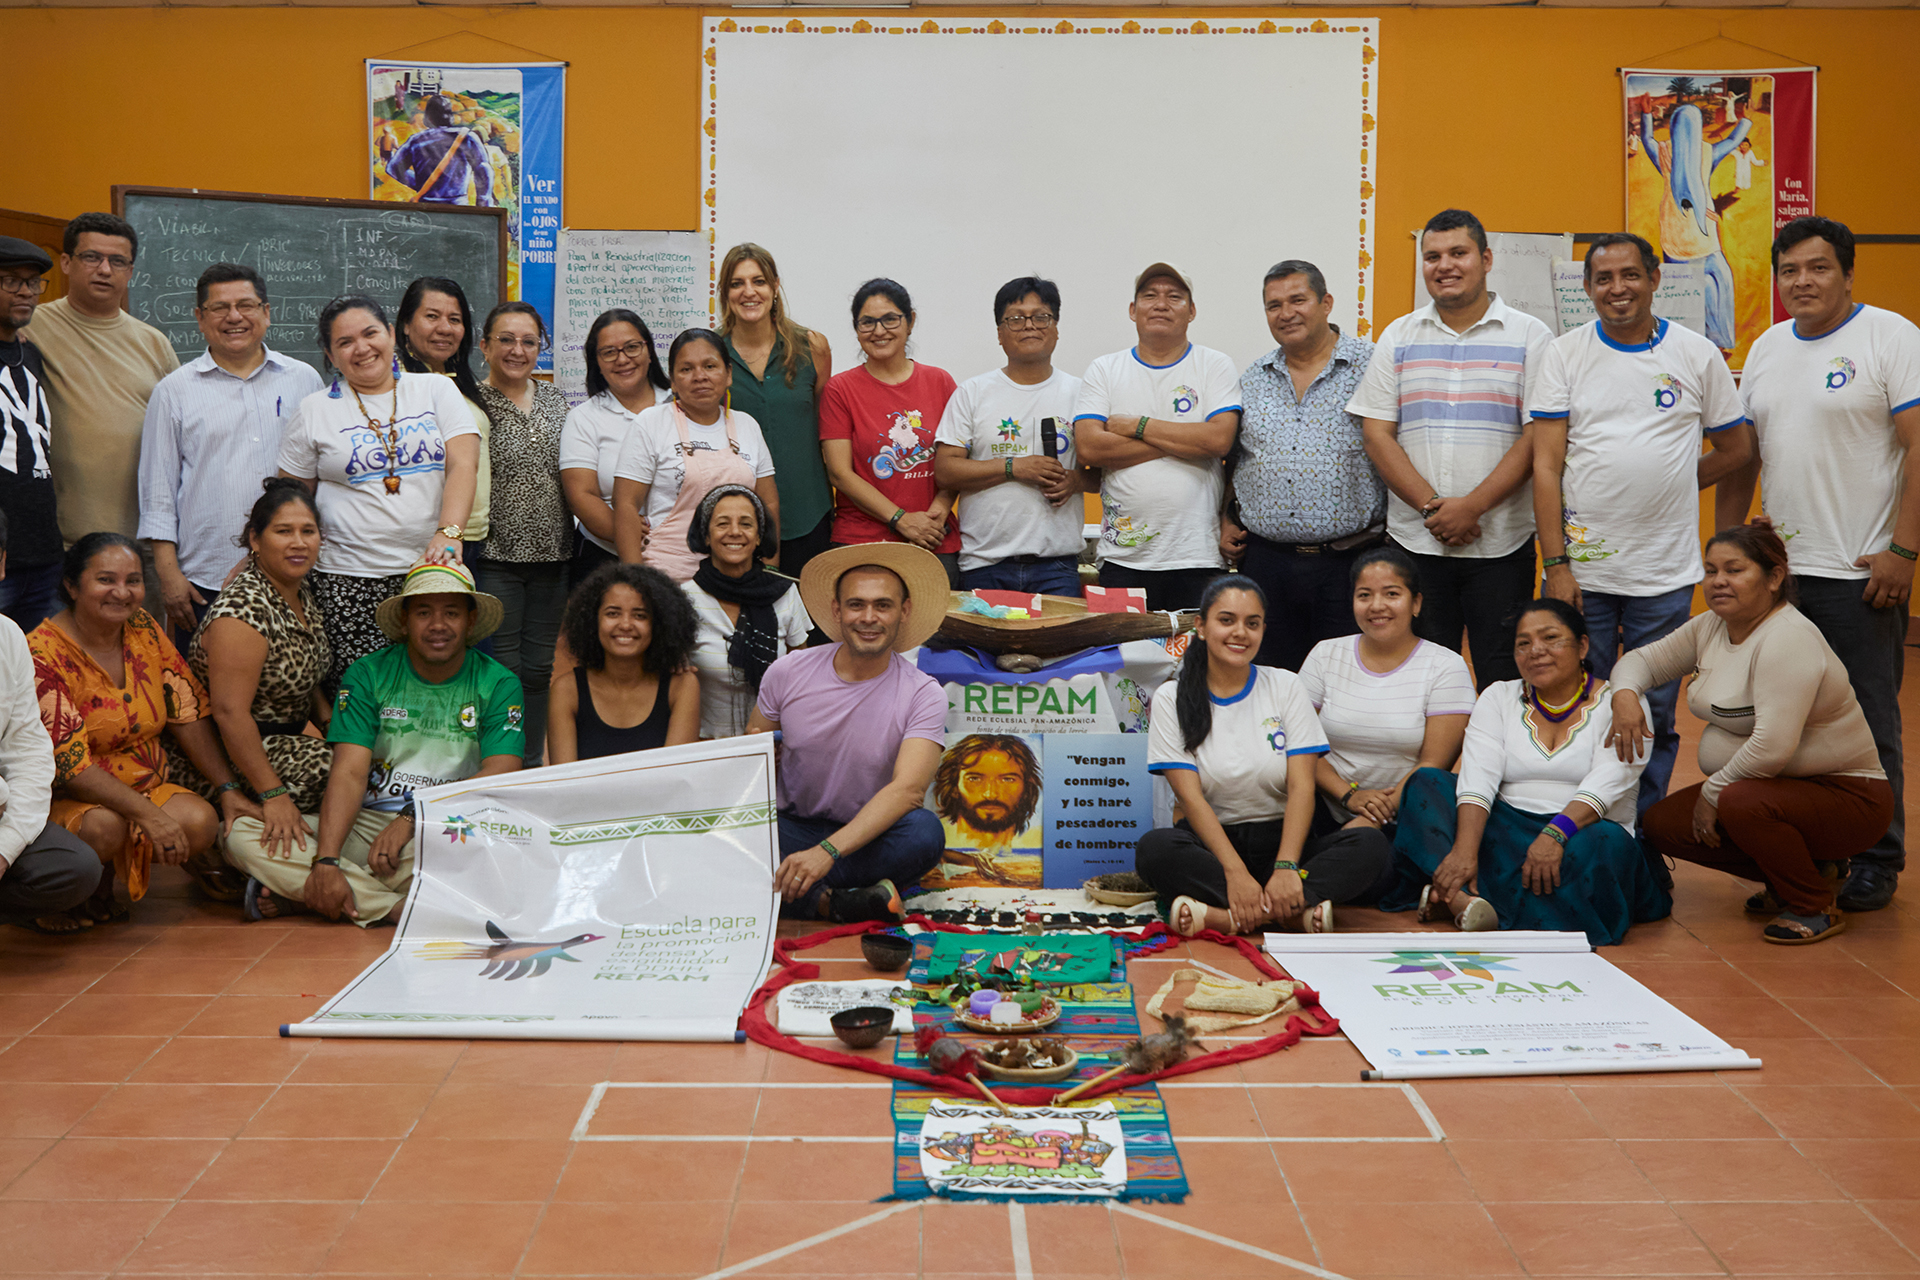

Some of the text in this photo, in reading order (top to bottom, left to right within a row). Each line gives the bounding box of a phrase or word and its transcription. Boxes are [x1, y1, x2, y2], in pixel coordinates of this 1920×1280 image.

[527, 174, 556, 193] Ver
[1785, 177, 1802, 188] Con
[523, 196, 558, 204] EL MUNDO
[1777, 204, 1809, 218] salgan
[531, 215, 558, 228] OJOS
[1775, 217, 1791, 229] de
[529, 237, 553, 248] niño
[567, 250, 587, 261] Para
[592, 251, 600, 260] la
[602, 263, 616, 273] del
[166, 275, 199, 288] ECON
[566, 274, 579, 285] del
[583, 275, 606, 284] cobre
[611, 277, 618, 287] y
[652, 275, 695, 285] minerales
[569, 298, 601, 308] mineral
[164, 303, 196, 317] SOCI
[569, 308, 588, 318] Para
[645, 320, 688, 329] ostenible
[351, 422, 430, 447] FÓUM
[991, 443, 1028, 454] REPAM
[964, 685, 1096, 715] REPAM
[393, 771, 467, 787] GOBERNA
[1064, 776, 1130, 788] conmigo,
[1061, 796, 1132, 808] y los haré
[480, 821, 532, 837] REPAM
[1056, 818, 1137, 829] pescadores
[1055, 840, 1073, 849] de
[621, 915, 757, 940] Escuela para
[617, 931, 761, 950] la promoción,
[611, 949, 715, 958] defensa y
[605, 956, 729, 965] exigibilidad
[593, 973, 710, 982] REPAM
[1372, 980, 1584, 997] REPAM
